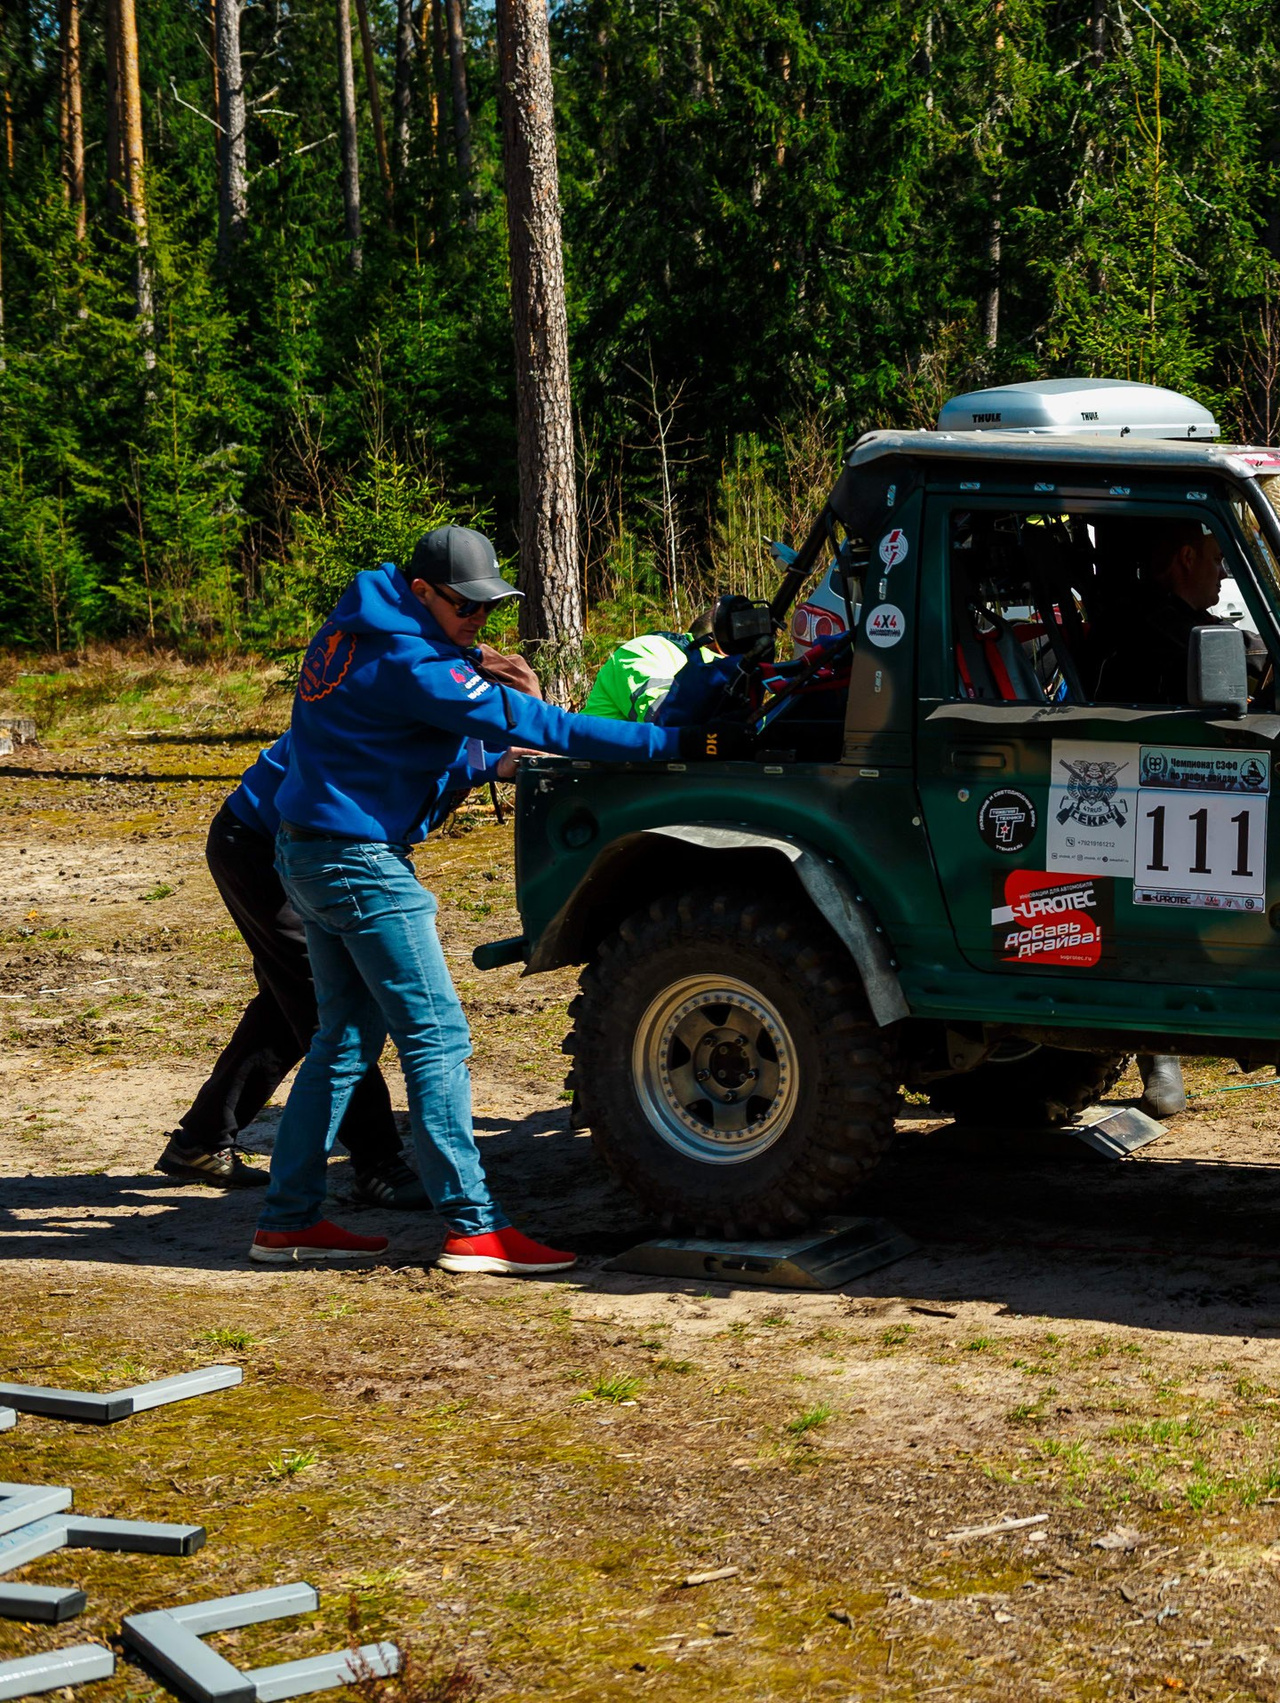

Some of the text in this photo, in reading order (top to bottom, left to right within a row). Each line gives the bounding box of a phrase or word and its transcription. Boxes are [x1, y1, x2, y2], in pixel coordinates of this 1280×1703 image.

[972, 413, 1001, 423] THULE
[1081, 411, 1099, 421] THULE
[873, 614, 897, 628] 4X4
[1171, 758, 1238, 771] Чемпионат СЗФО
[1070, 809, 1116, 826] СЕКАЧ
[1146, 805, 1253, 877] 111
